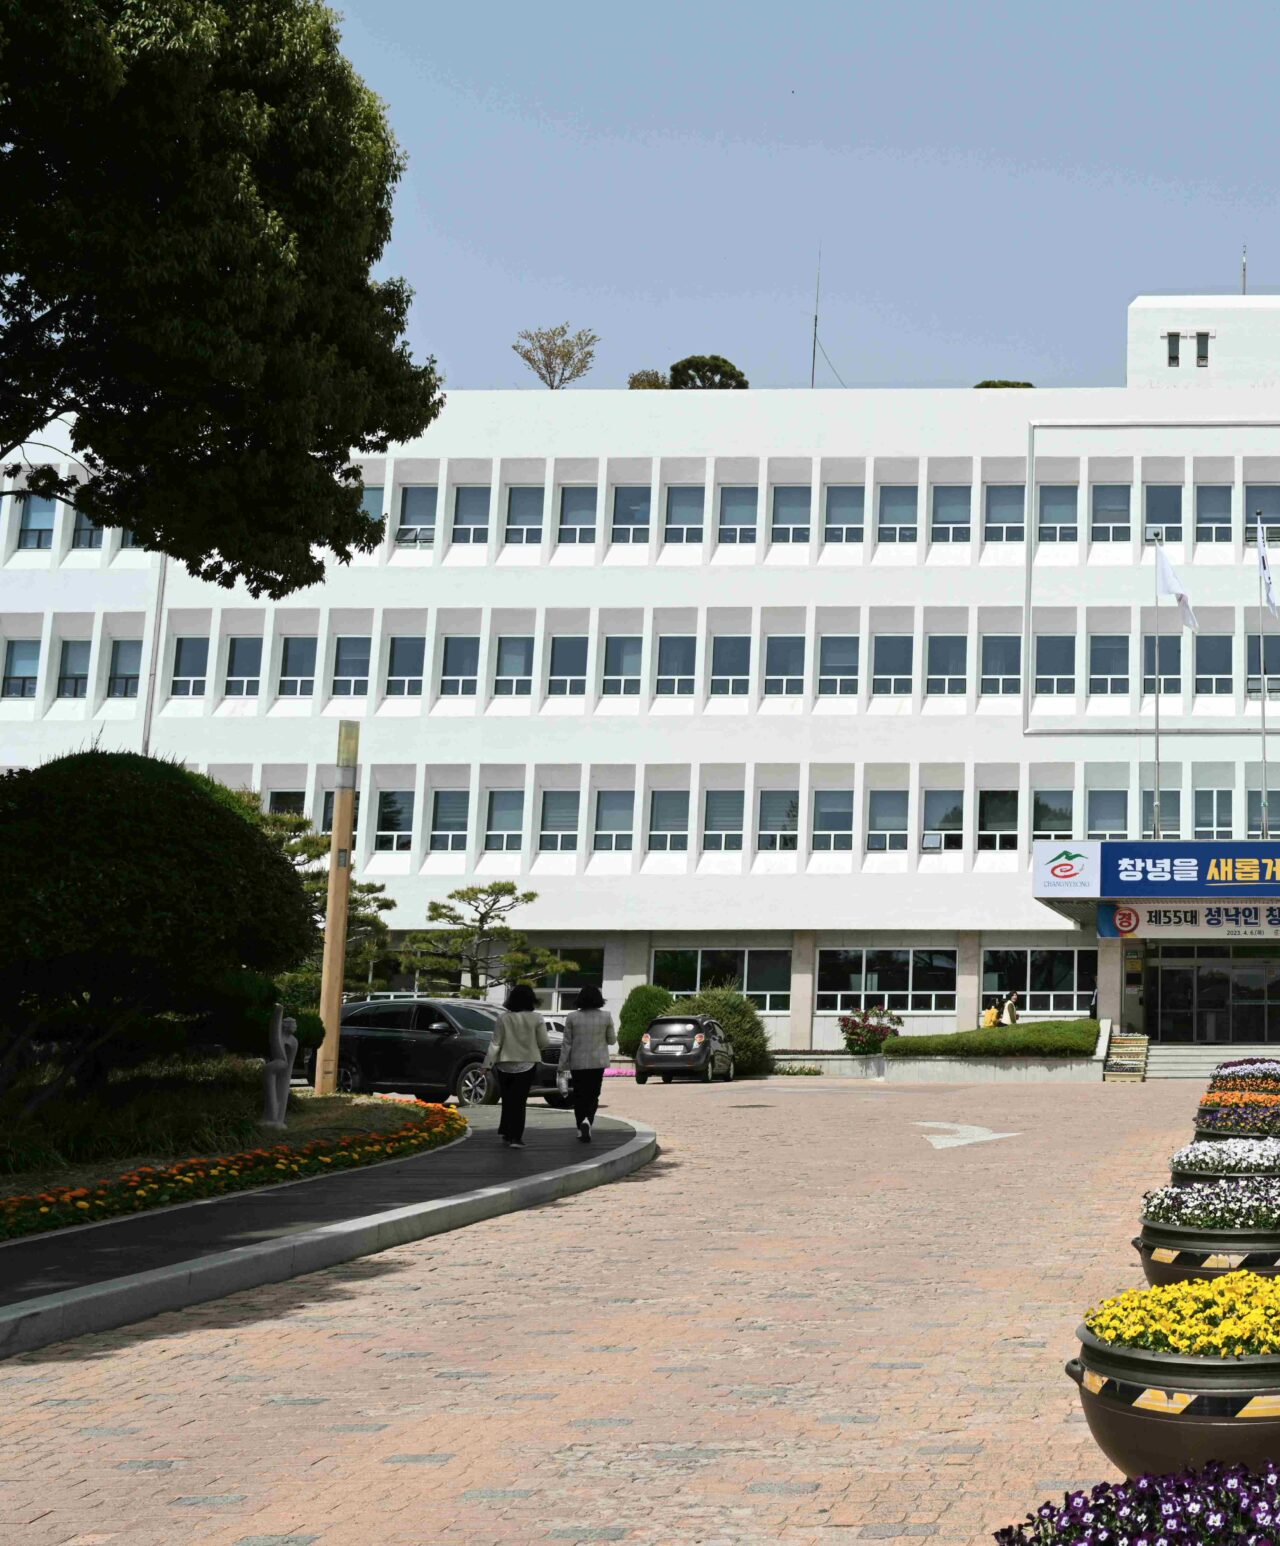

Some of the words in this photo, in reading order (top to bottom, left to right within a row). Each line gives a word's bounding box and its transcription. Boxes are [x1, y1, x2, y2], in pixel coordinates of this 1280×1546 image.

[1117, 858, 1199, 882] 창녕을
[1118, 912, 1133, 928] 경
[1146, 909, 1199, 926] 제55대
[1204, 906, 1260, 927] 성낙인
